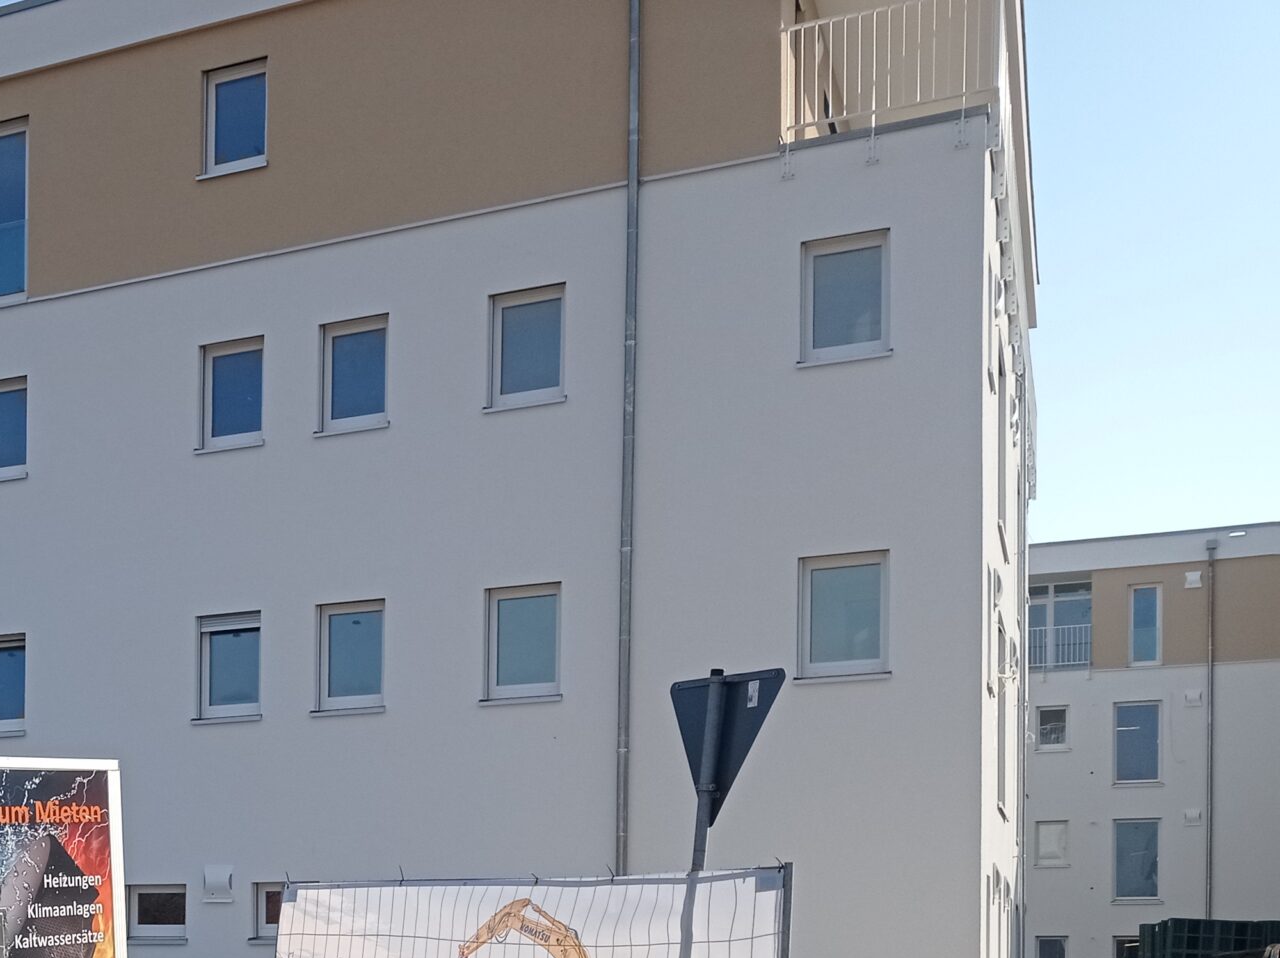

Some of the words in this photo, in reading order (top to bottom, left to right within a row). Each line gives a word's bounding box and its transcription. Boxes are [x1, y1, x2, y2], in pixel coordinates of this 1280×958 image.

[35, 800, 102, 823] Mieten
[43, 872, 102, 890] Heizungen
[27, 901, 103, 919] Klimaanlagen
[14, 928, 105, 949] Kaltwassersätze
